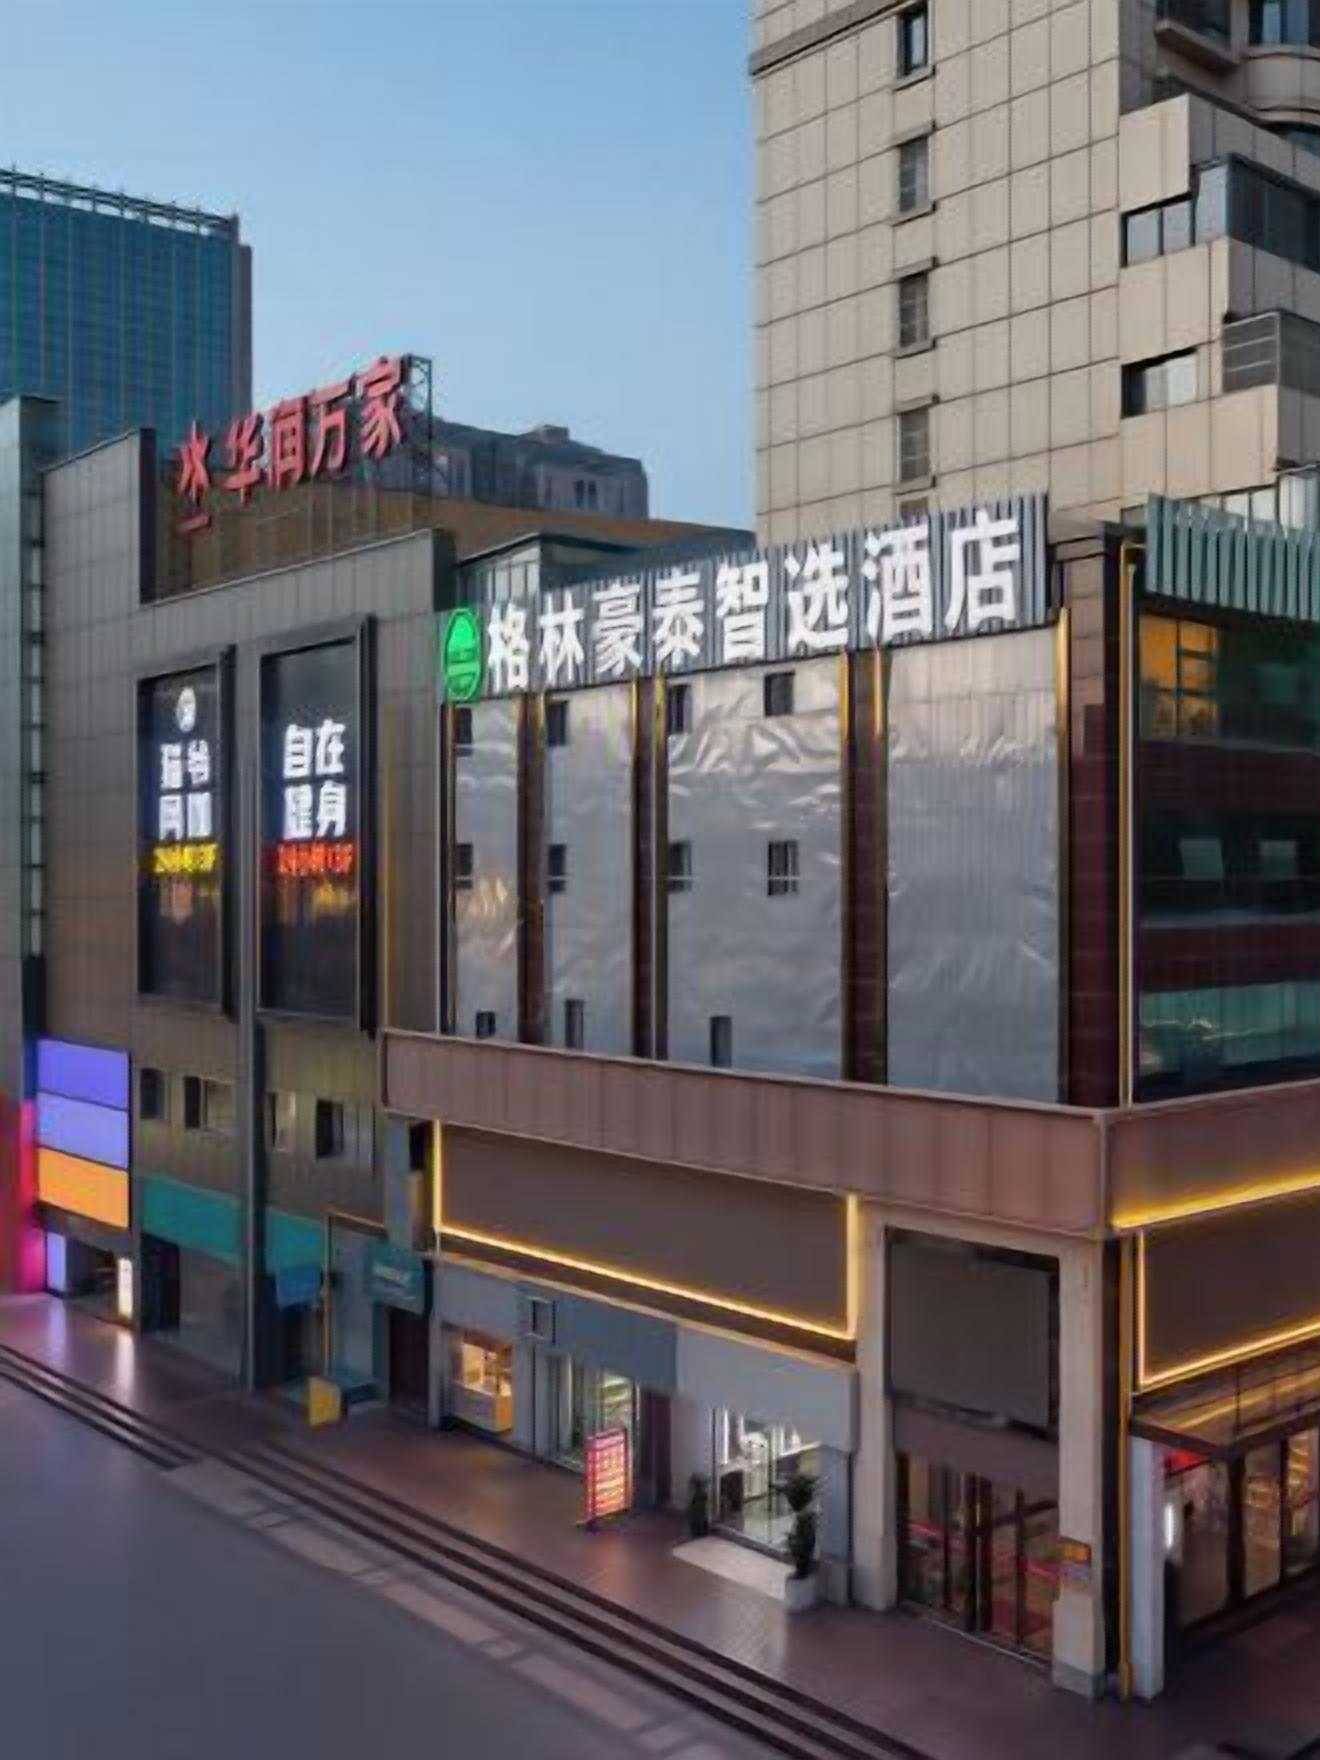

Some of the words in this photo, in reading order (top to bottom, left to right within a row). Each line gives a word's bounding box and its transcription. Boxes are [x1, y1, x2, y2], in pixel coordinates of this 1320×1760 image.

[222, 354, 403, 505] 华润万家
[486, 507, 1023, 693] 格林豪泰智选酒店
[284, 718, 346, 780] 自在
